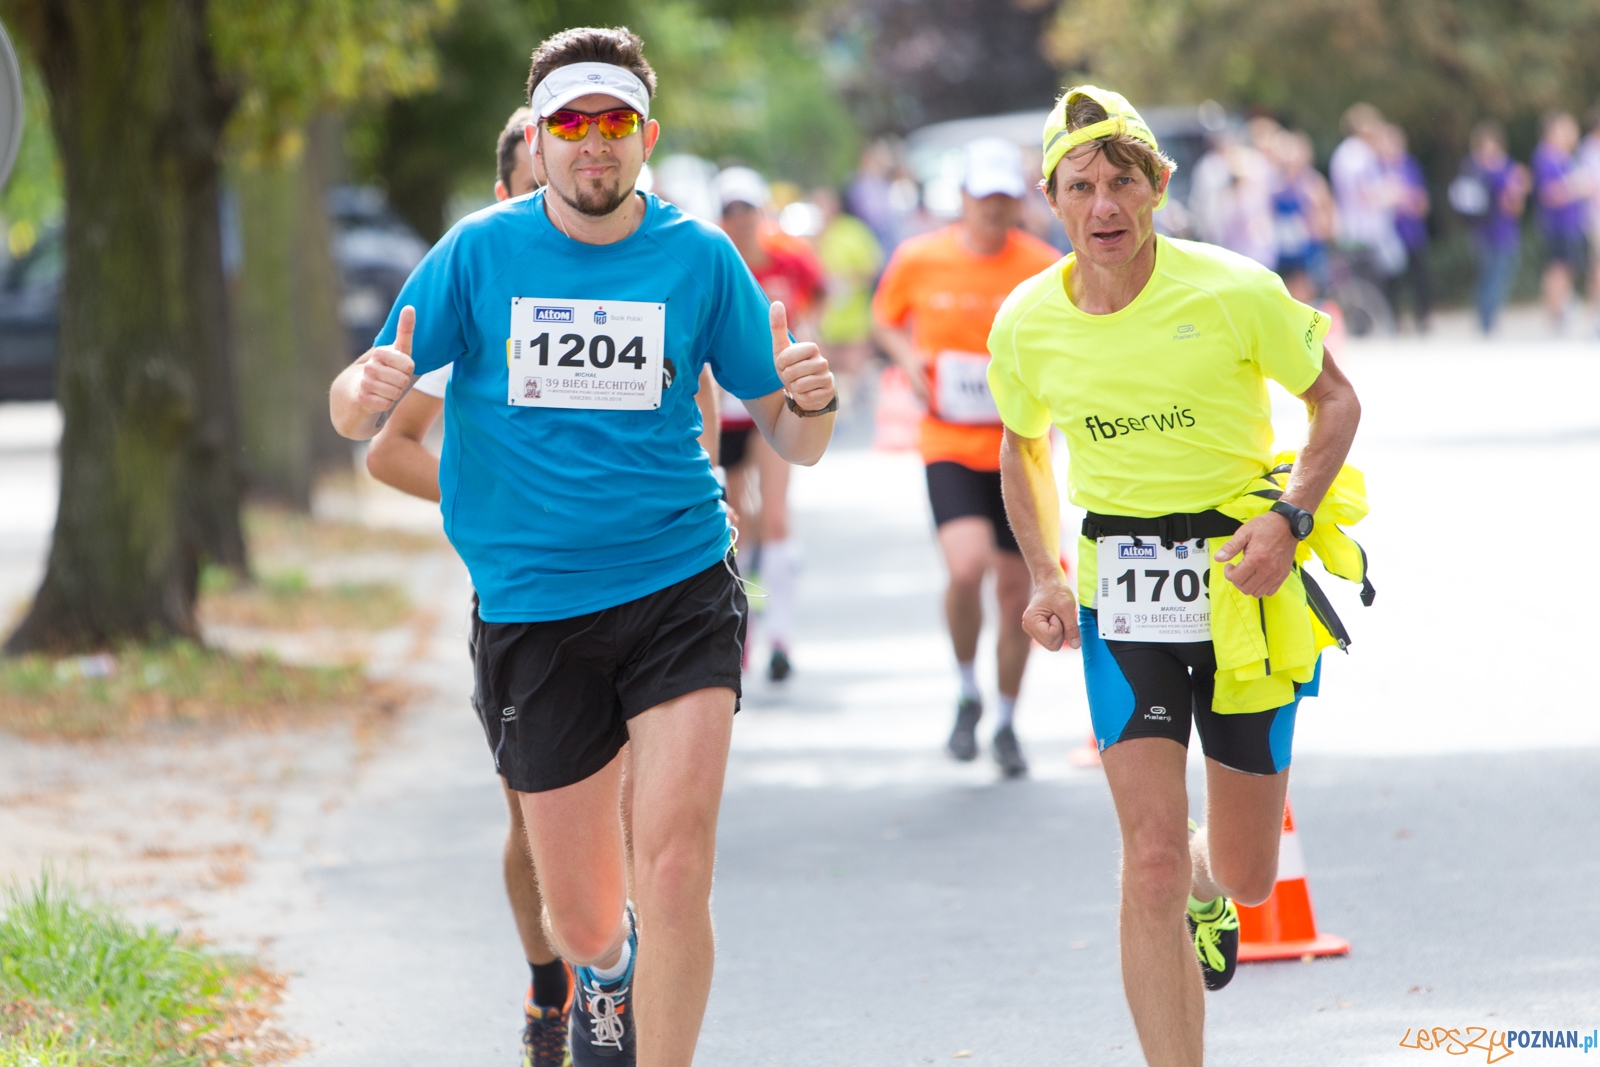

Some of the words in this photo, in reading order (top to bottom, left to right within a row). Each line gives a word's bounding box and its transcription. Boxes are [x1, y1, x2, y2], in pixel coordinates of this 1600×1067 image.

[530, 332, 646, 370] 1204
[545, 378, 559, 389] 39
[562, 379, 588, 389] BIEG
[591, 379, 648, 391] LECHITÓW
[1085, 405, 1196, 441] fbserwis
[1134, 614, 1148, 624] 39
[1151, 613, 1176, 623] BIEG
